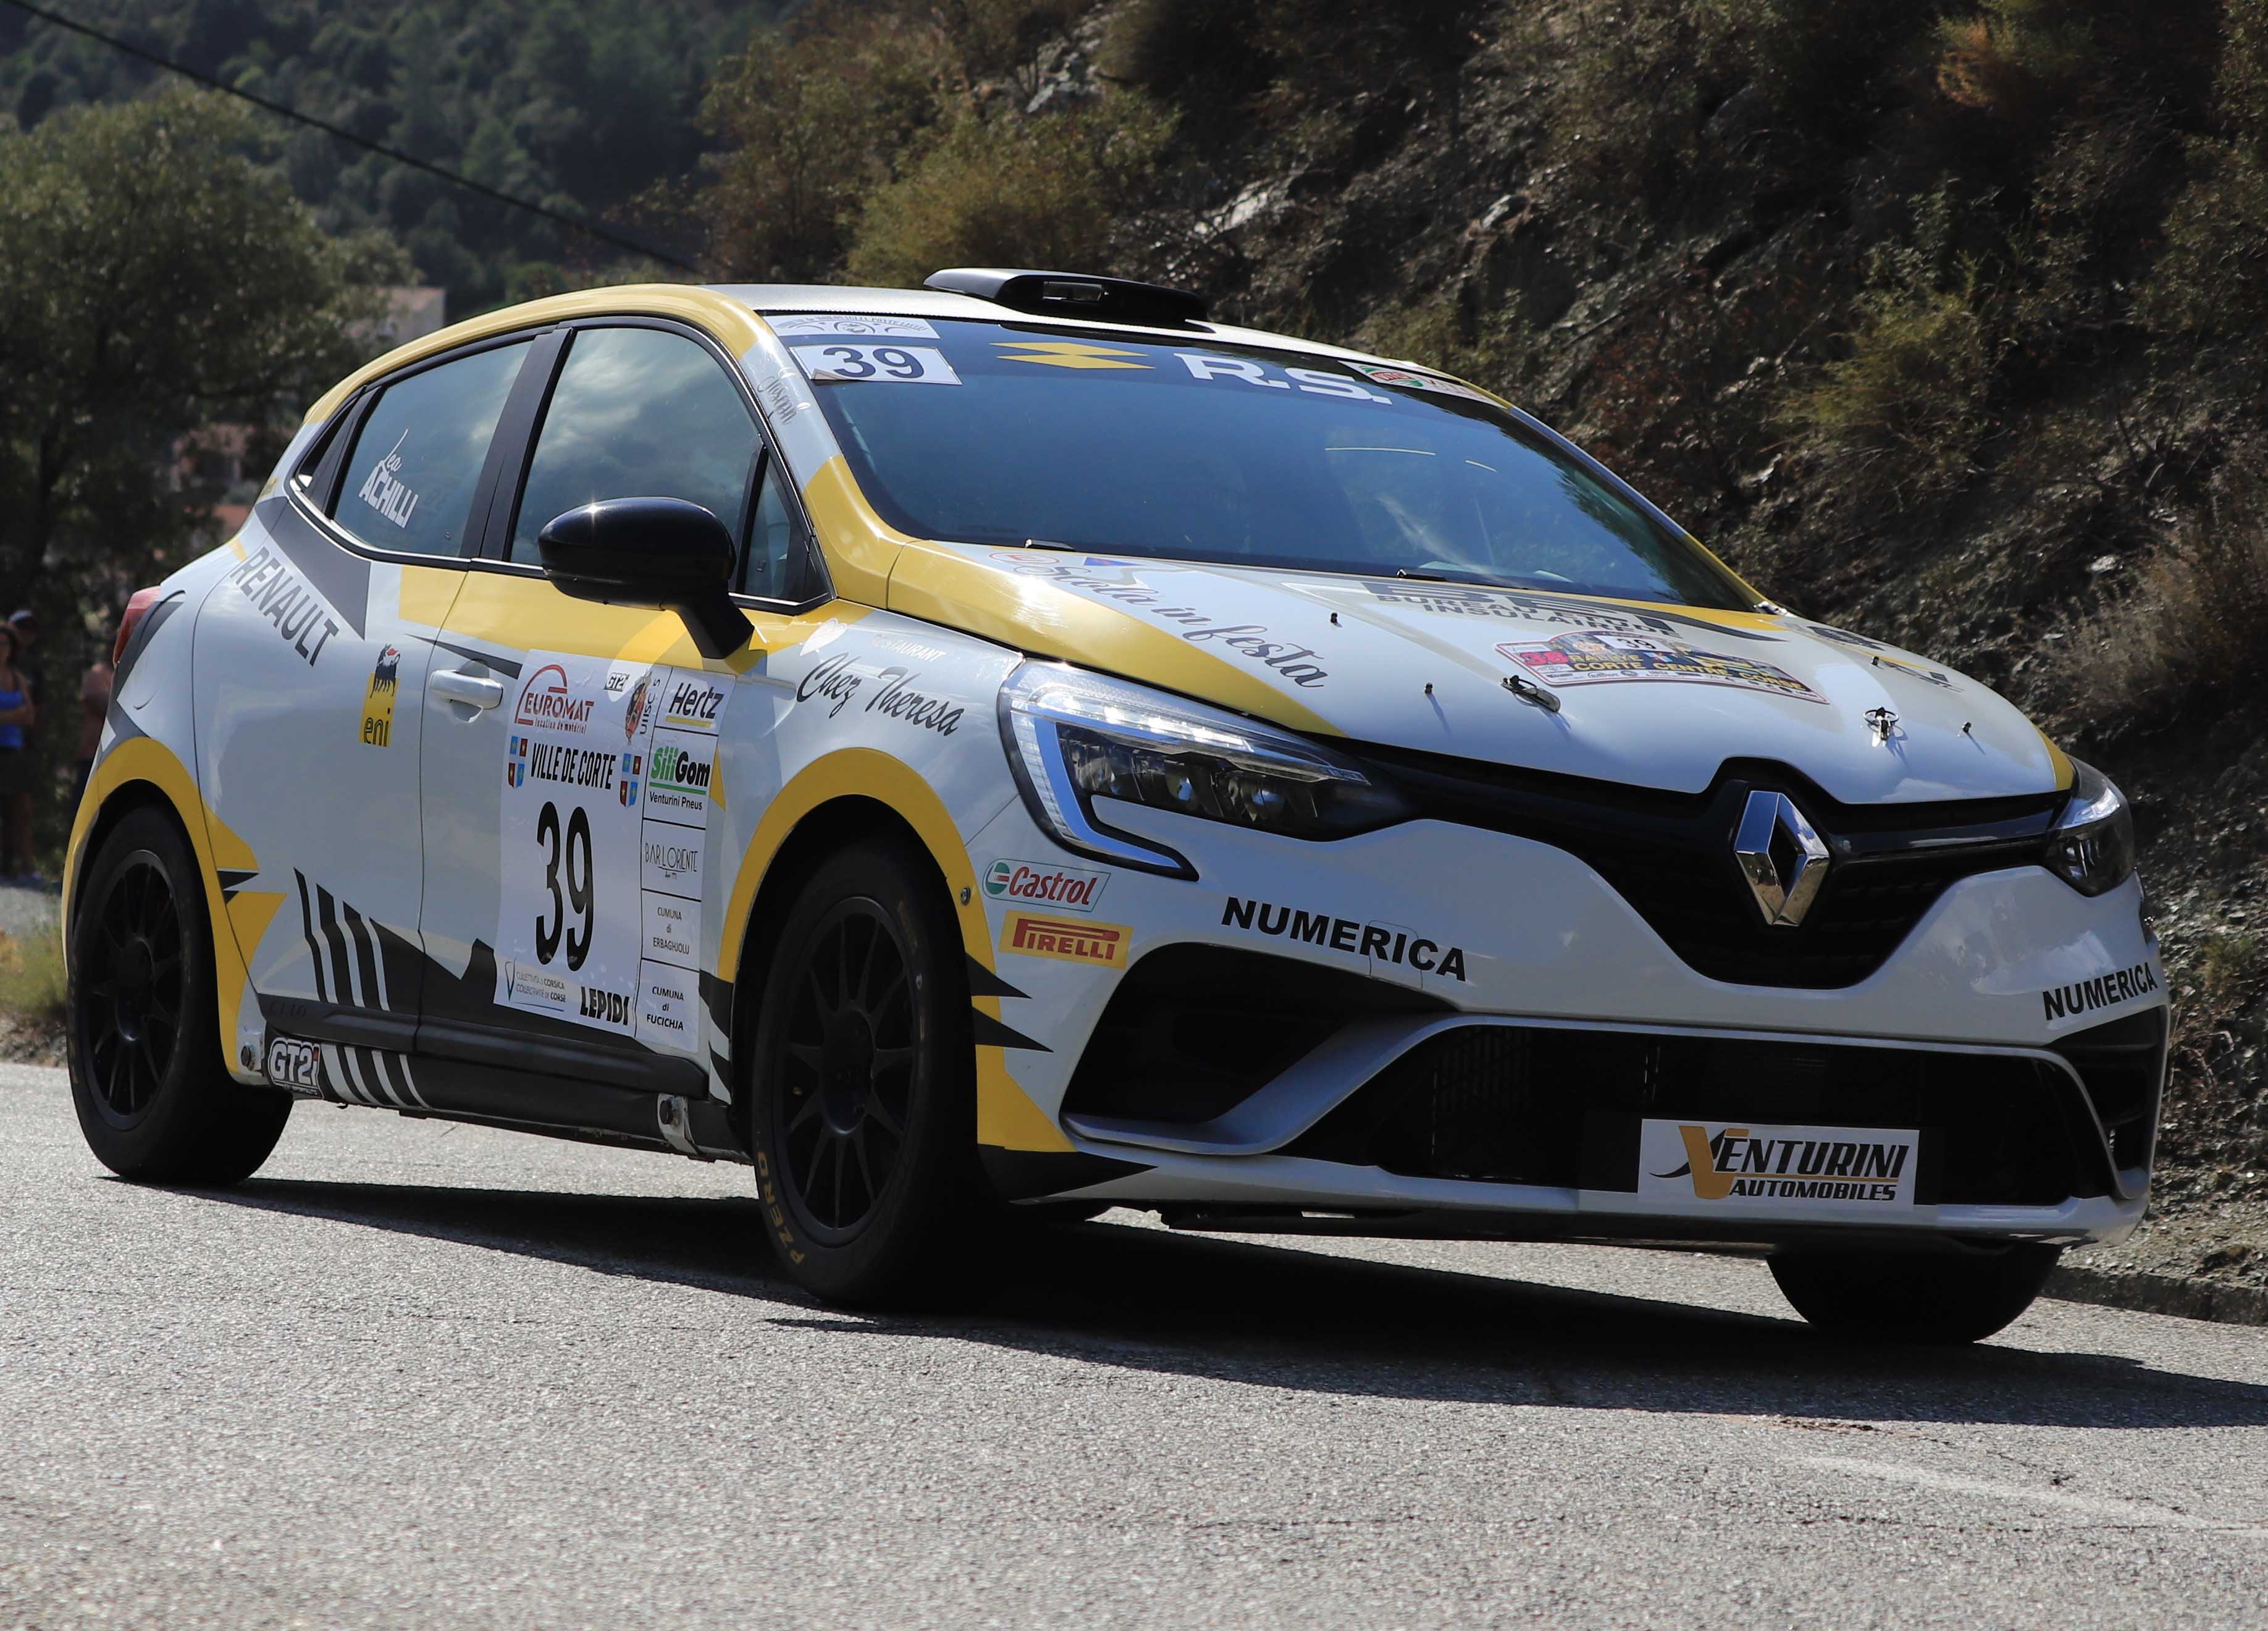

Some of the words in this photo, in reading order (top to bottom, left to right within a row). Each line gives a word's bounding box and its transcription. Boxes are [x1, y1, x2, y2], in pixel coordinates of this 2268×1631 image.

[823, 347, 925, 379] 39
[1174, 353, 1392, 405] R.S.
[358, 465, 420, 529] ACHILLI
[229, 547, 340, 667] RENAULT
[1151, 607, 1212, 626] in
[1182, 625, 1329, 688] festa
[1519, 651, 1569, 666] 38
[1568, 653, 1644, 663] RALLYE
[1616, 638, 1657, 650] 39
[796, 652, 861, 719] Chez
[865, 666, 965, 736] Theresa
[1574, 661, 1647, 672] CORTE
[1653, 662, 1734, 677] CENTRE
[1739, 671, 1805, 691] CORSE
[524, 693, 595, 723] EUROMAT
[668, 682, 724, 720] Hertz
[363, 707, 391, 748] eni
[530, 743, 563, 782] VILLE
[563, 748, 576, 784] DE
[578, 750, 617, 790] CORTE
[651, 746, 712, 788] SiliGom
[650, 791, 680, 807] Venturini
[681, 796, 703, 811] Pneus
[536, 800, 594, 972] 39
[1009, 866, 1098, 905] Castrol
[657, 906, 682, 921] CUMUNA
[666, 924, 672, 934] di
[1012, 918, 1120, 960] PIRELLI
[1220, 896, 1467, 982] NUMERICA
[550, 991, 566, 1003] CORSE
[579, 986, 630, 1026] LEPIDI
[652, 985, 684, 1001] CUMUNA
[662, 1003, 670, 1012] di
[2042, 961, 2159, 1021] NUMERICA
[646, 1013, 684, 1031] FUCICHJA
[1678, 1125, 1910, 1200] VENTURINI
[1728, 1179, 1897, 1201] AUTOMOBILES
